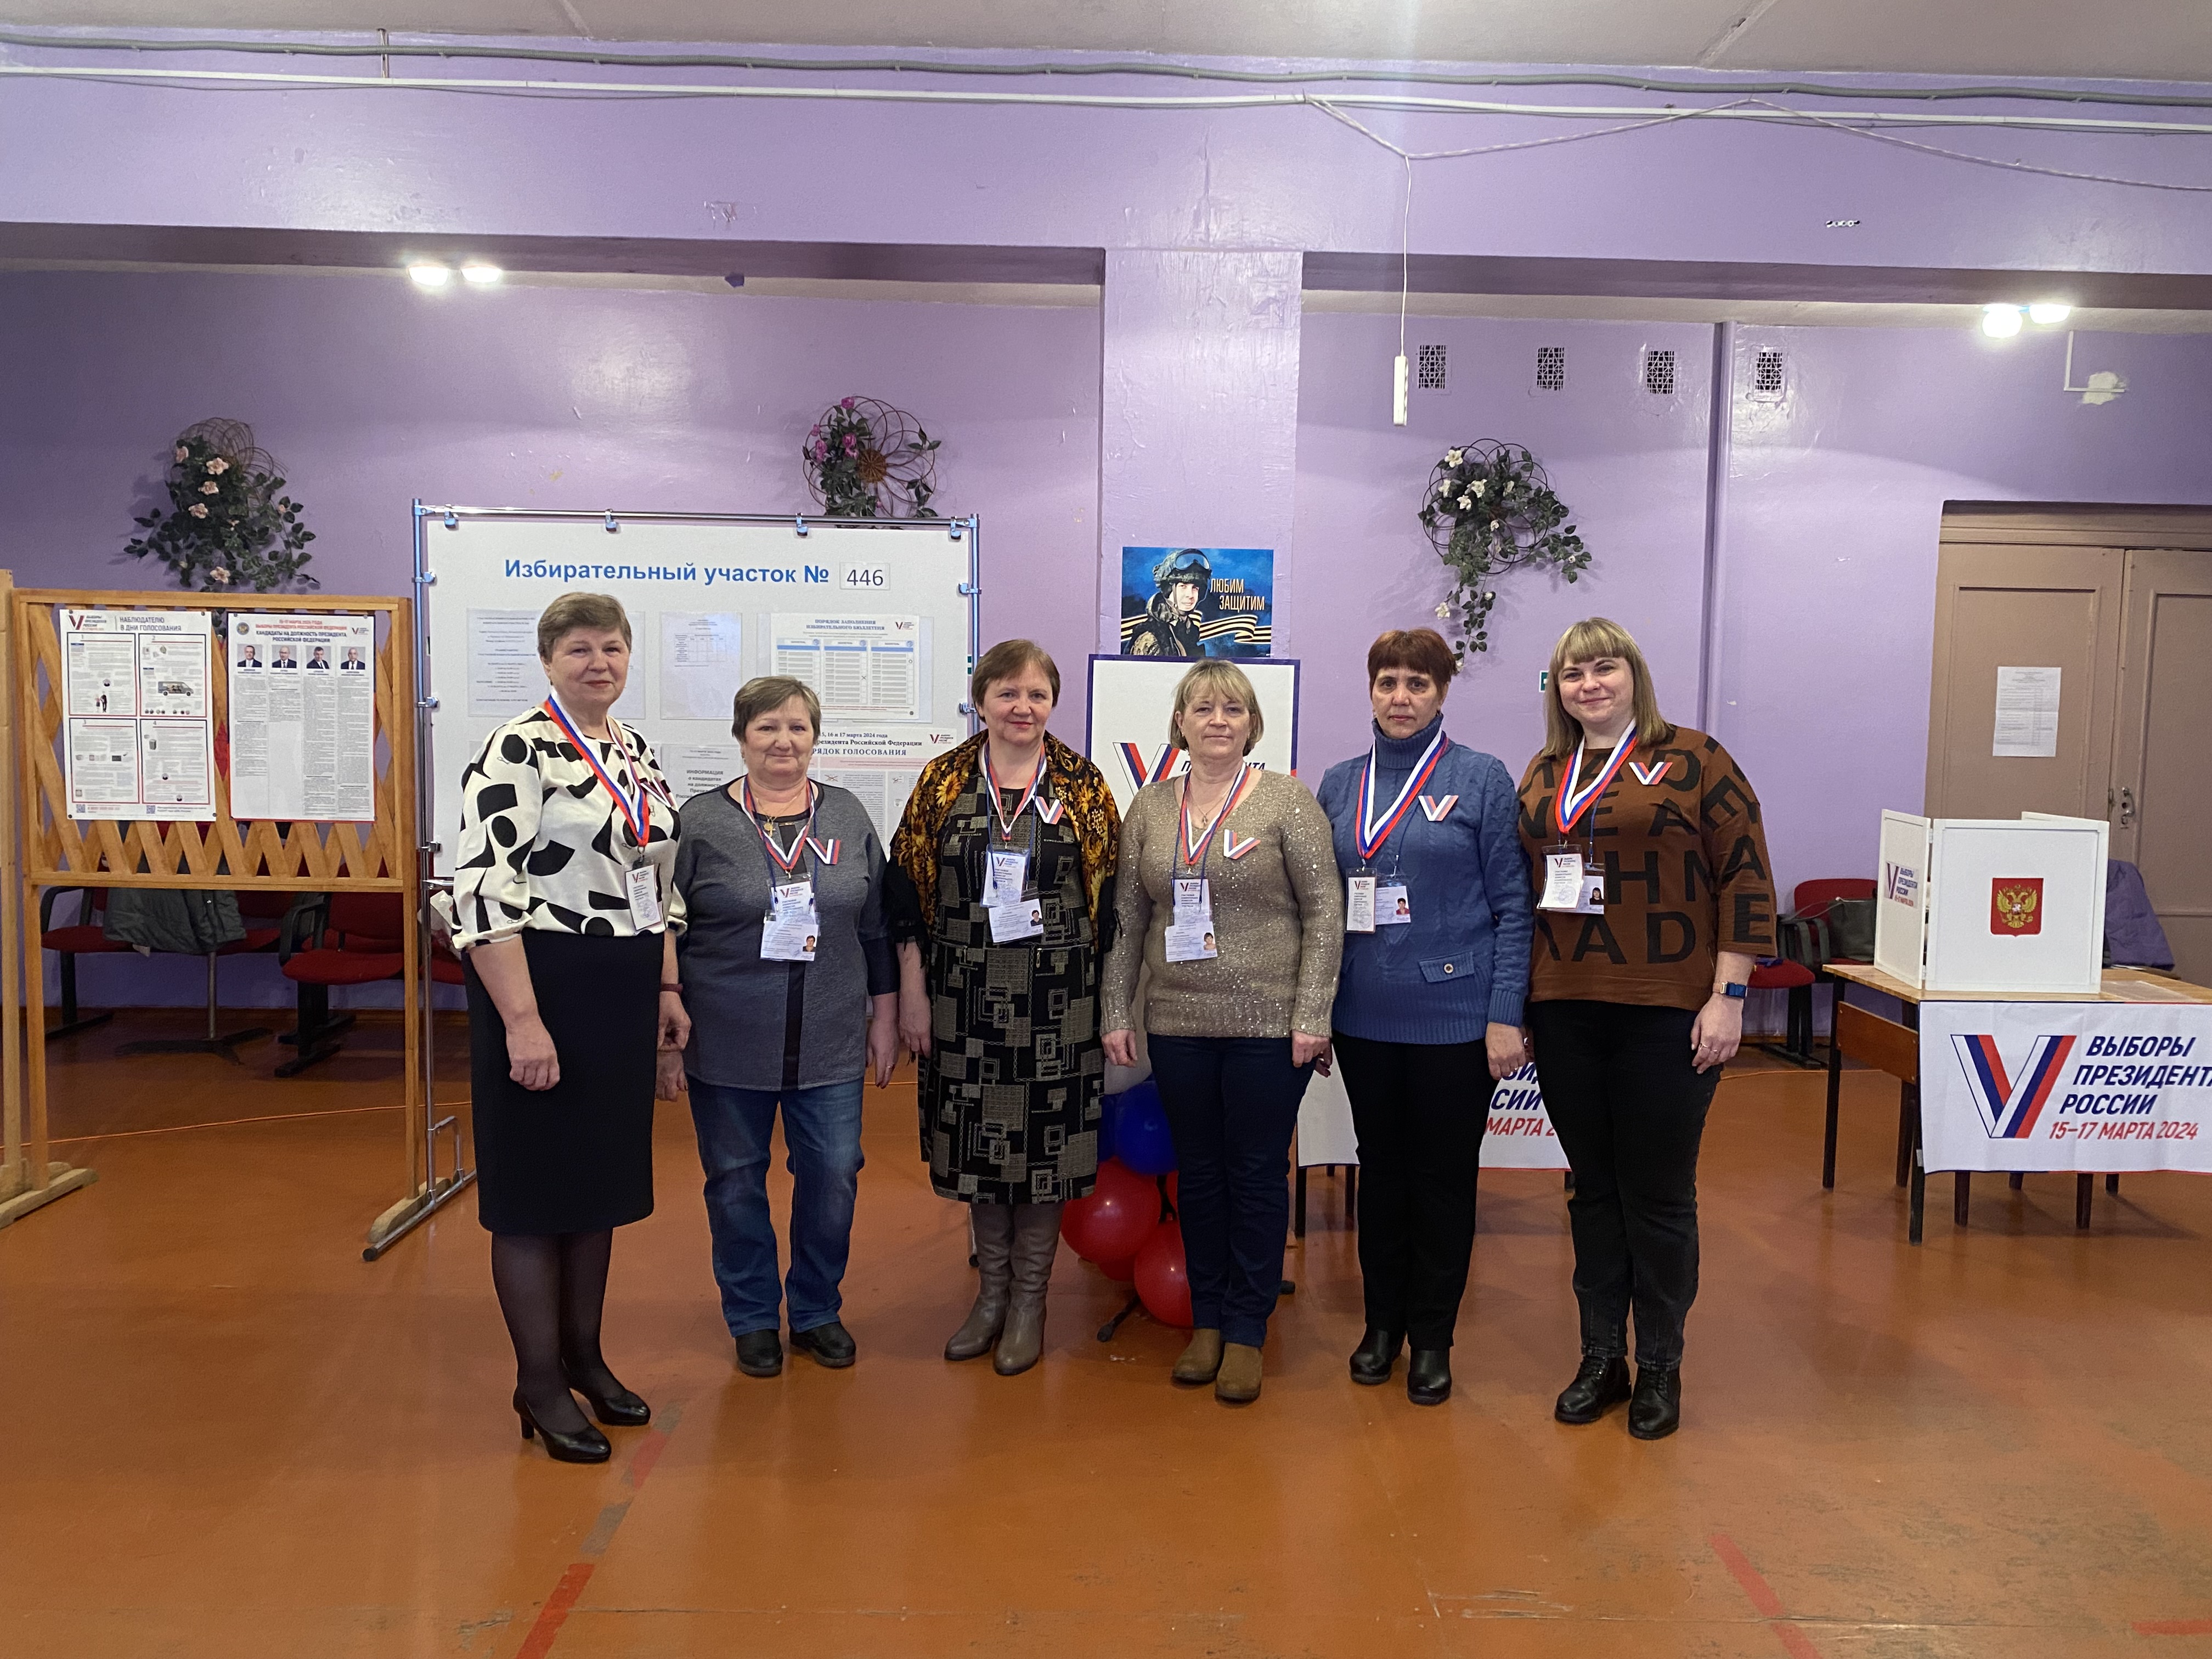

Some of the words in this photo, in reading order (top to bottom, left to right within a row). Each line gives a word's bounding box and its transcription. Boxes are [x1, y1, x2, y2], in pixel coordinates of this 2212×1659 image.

[505, 559, 696, 582] Избирательный
[704, 565, 795, 585] участок
[804, 565, 829, 583] №
[846, 568, 883, 586] 446
[1210, 578, 1244, 593] ЛЮБИМ
[1219, 595, 1265, 613] ЗАЩИТИМ
[2086, 1036, 2196, 1057] ВЫБОРЫ
[2059, 1094, 2158, 1115] РОССИИ
[1485, 1117, 1544, 1136] МАРТА
[2097, 1122, 2156, 1139] МАРТА
[2156, 1121, 2199, 1140] 2024
